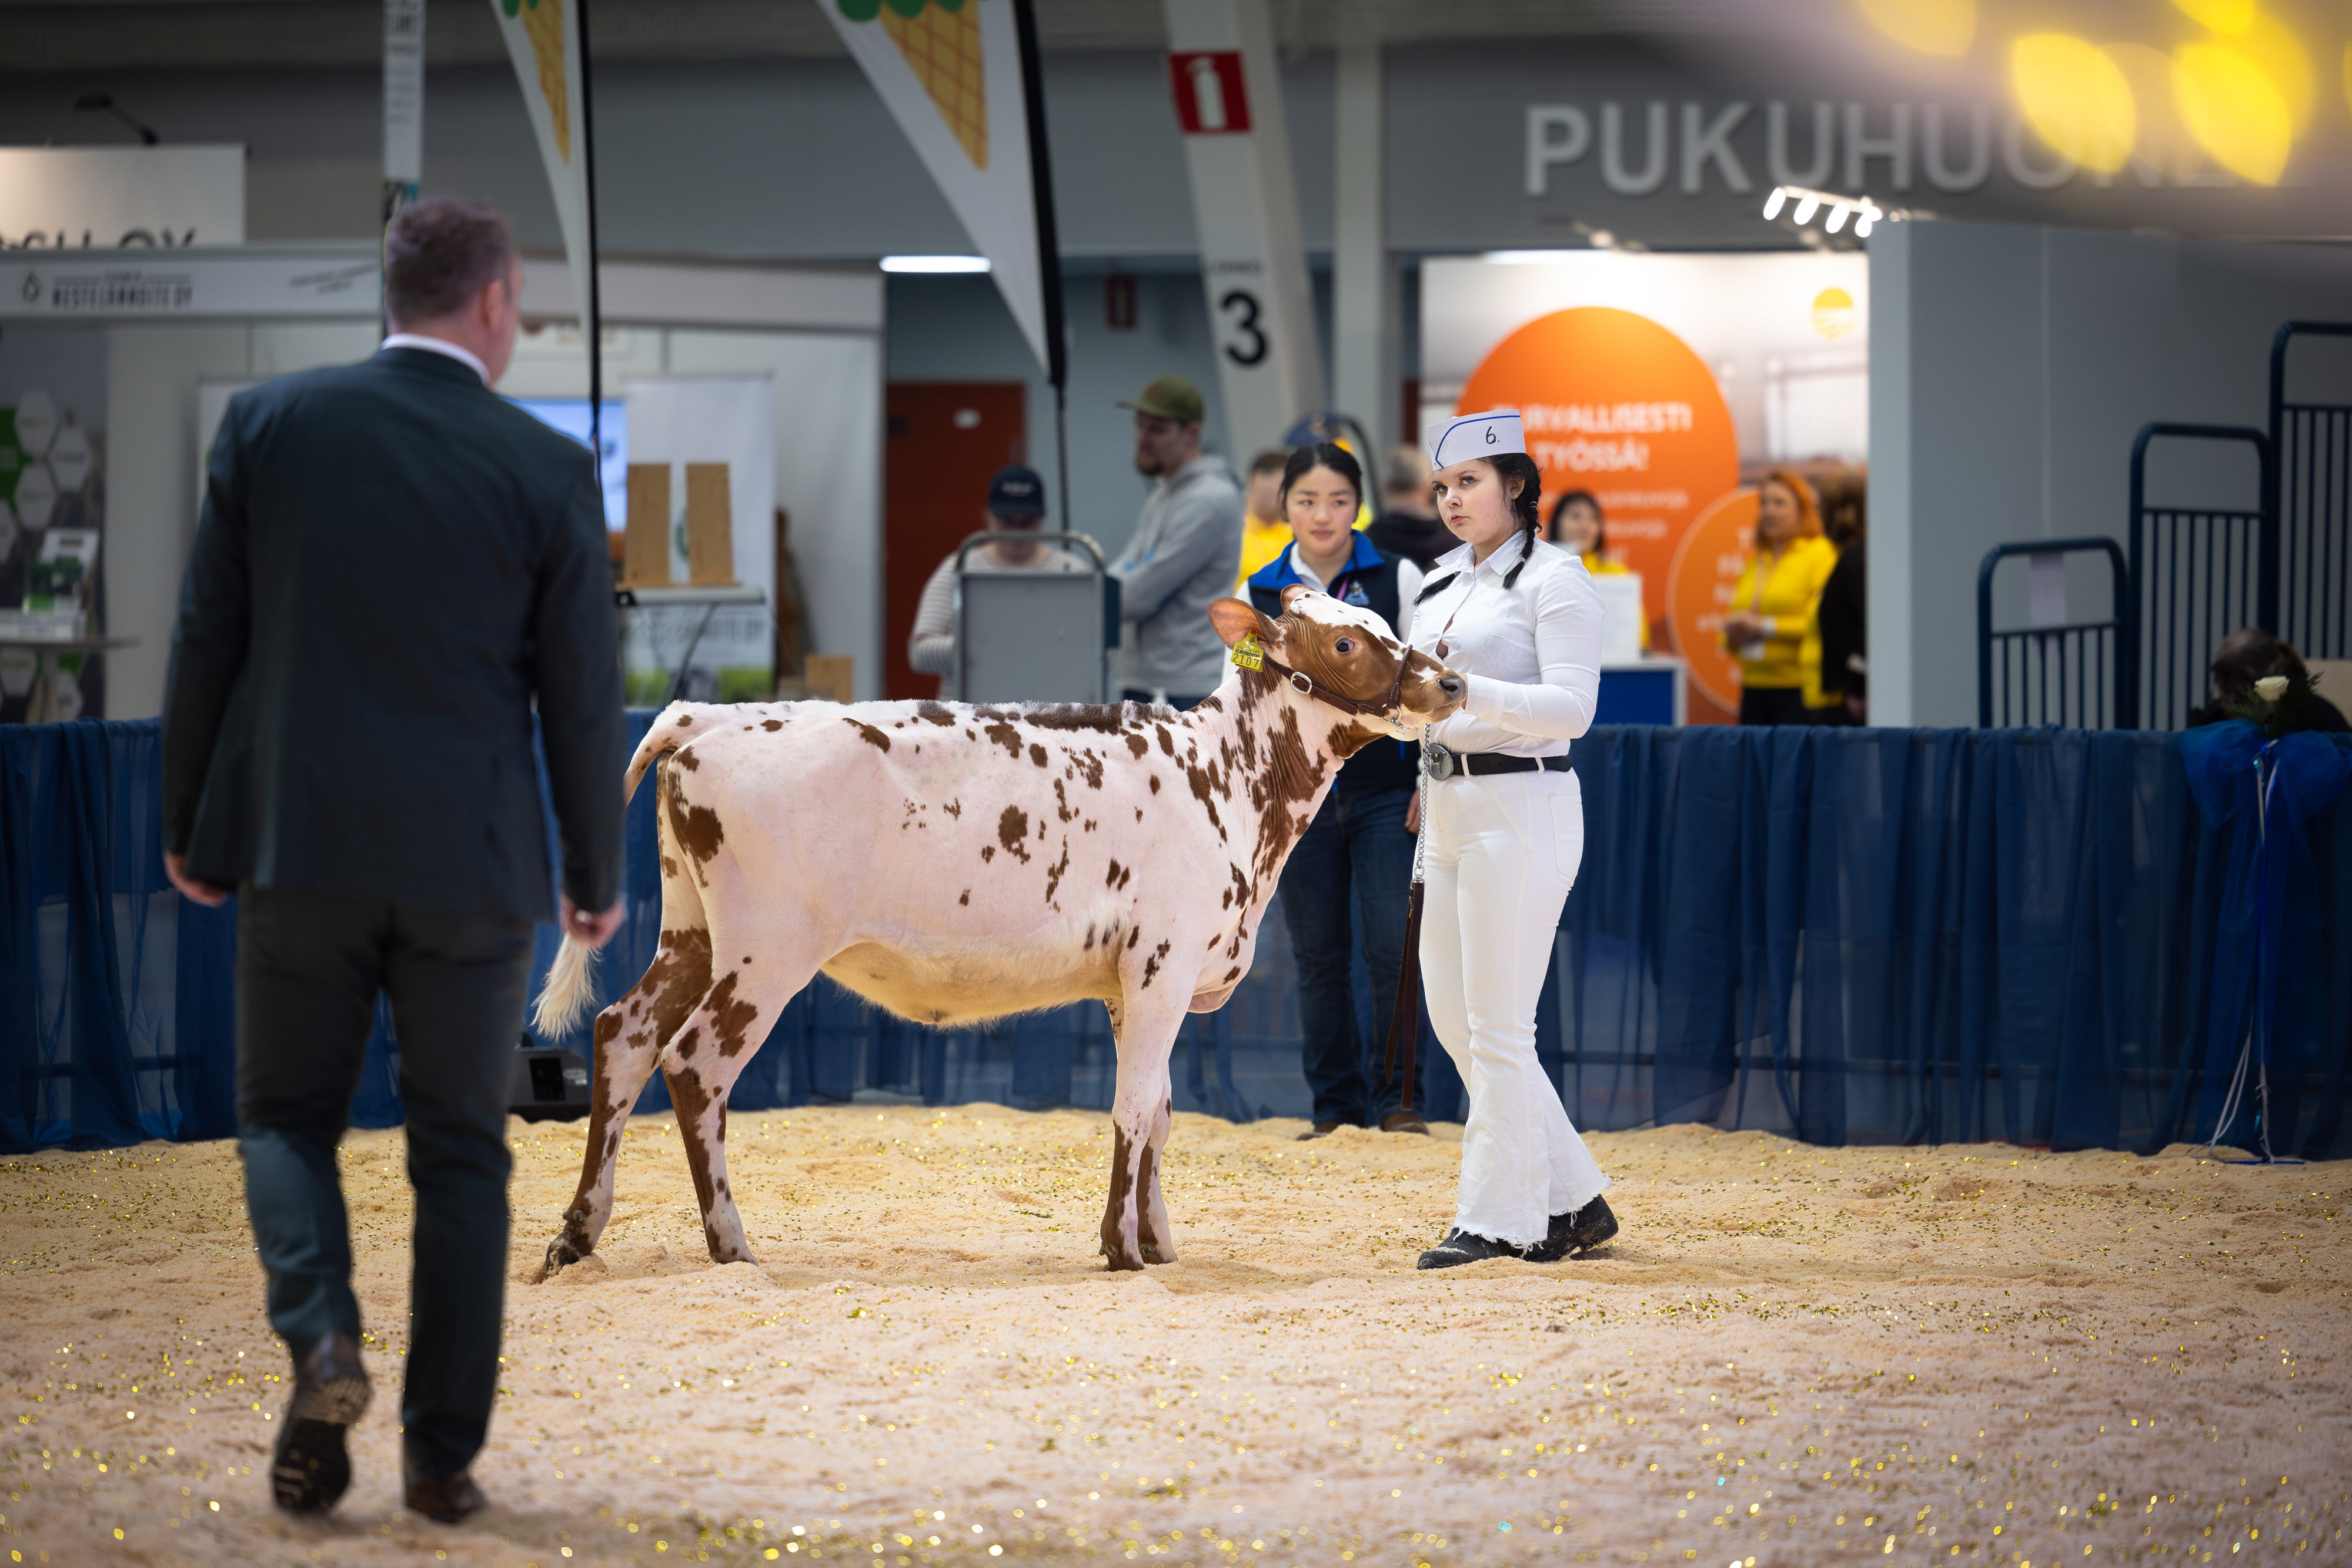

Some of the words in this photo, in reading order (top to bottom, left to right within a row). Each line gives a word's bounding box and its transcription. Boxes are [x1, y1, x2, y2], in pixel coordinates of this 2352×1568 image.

[1221, 289, 1268, 367] 3
[1489, 402, 1692, 434] RVALLISESTI
[1485, 426, 1500, 444] 6.
[1232, 653, 1259, 668] 2107
